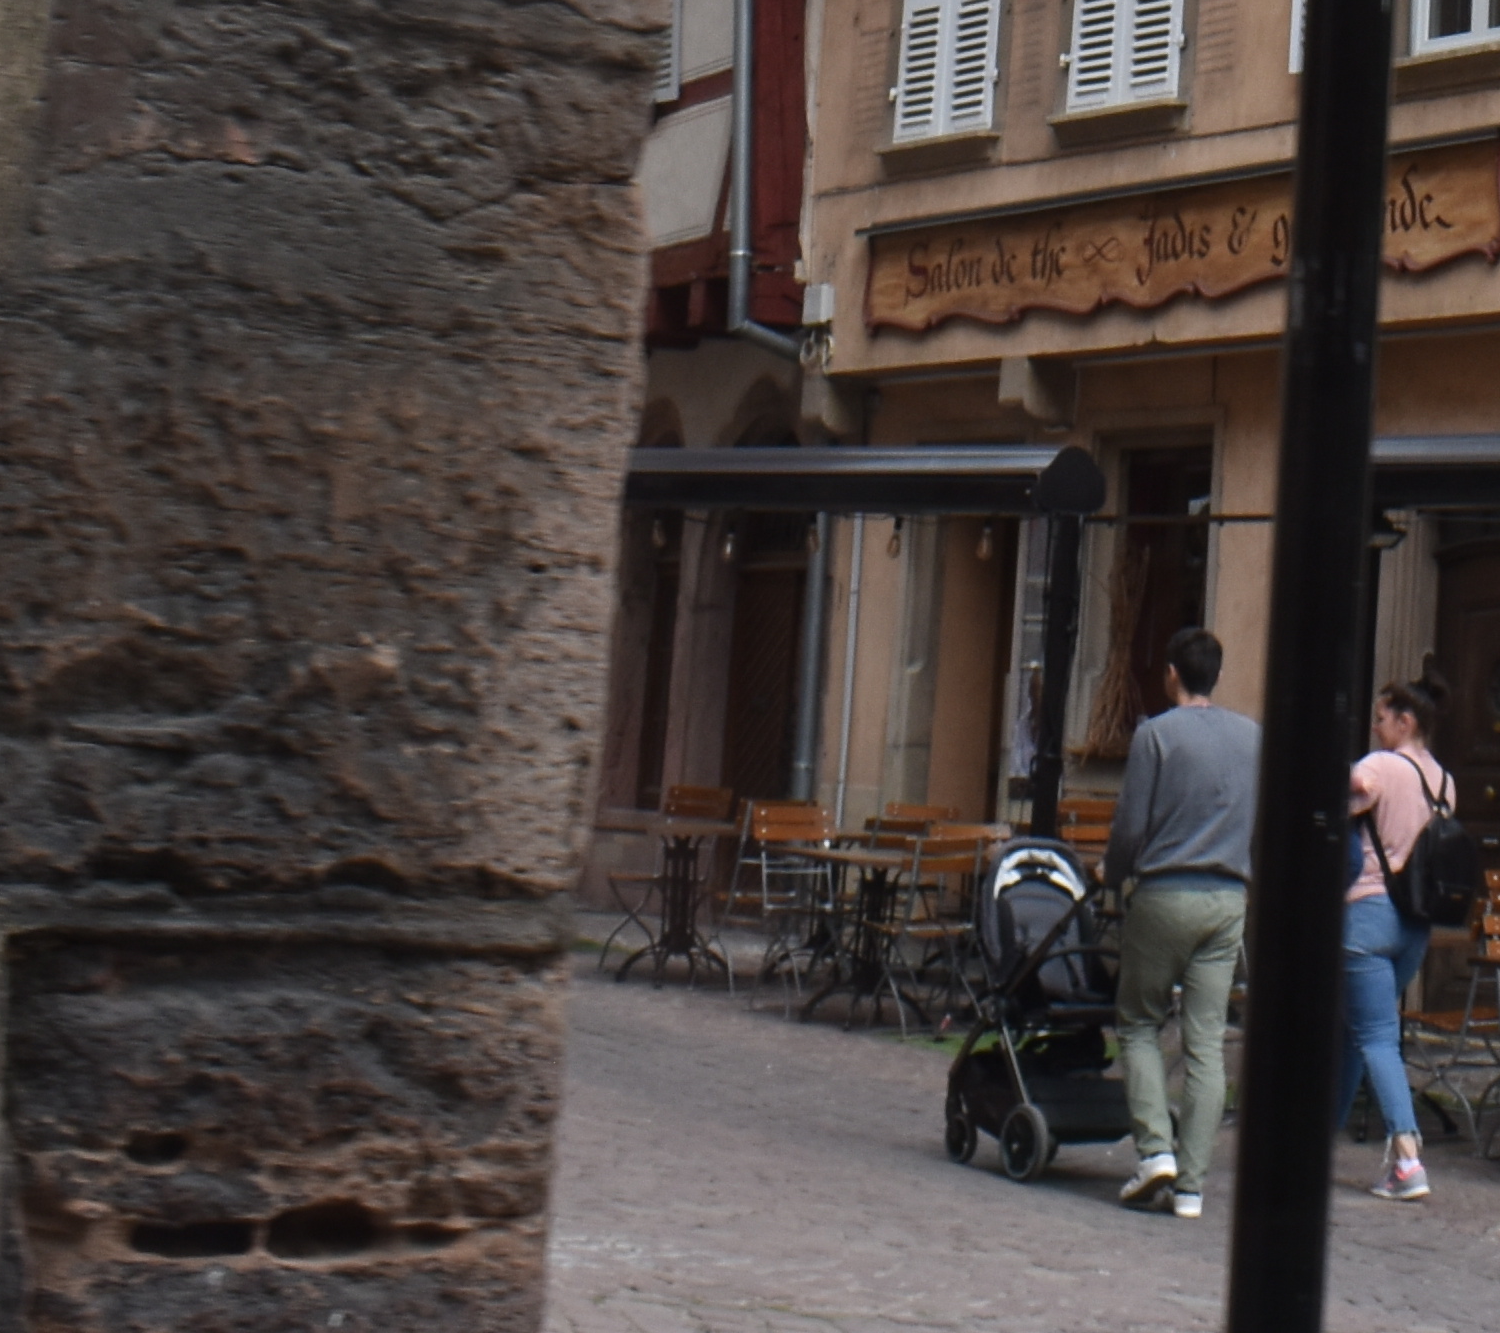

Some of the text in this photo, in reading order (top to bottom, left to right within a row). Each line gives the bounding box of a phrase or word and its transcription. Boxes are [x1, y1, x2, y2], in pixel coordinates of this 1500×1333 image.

[904, 239, 982, 306] Salon
[991, 237, 1017, 286] de
[1135, 201, 1211, 285] Jadis
[1227, 206, 1258, 254] &
